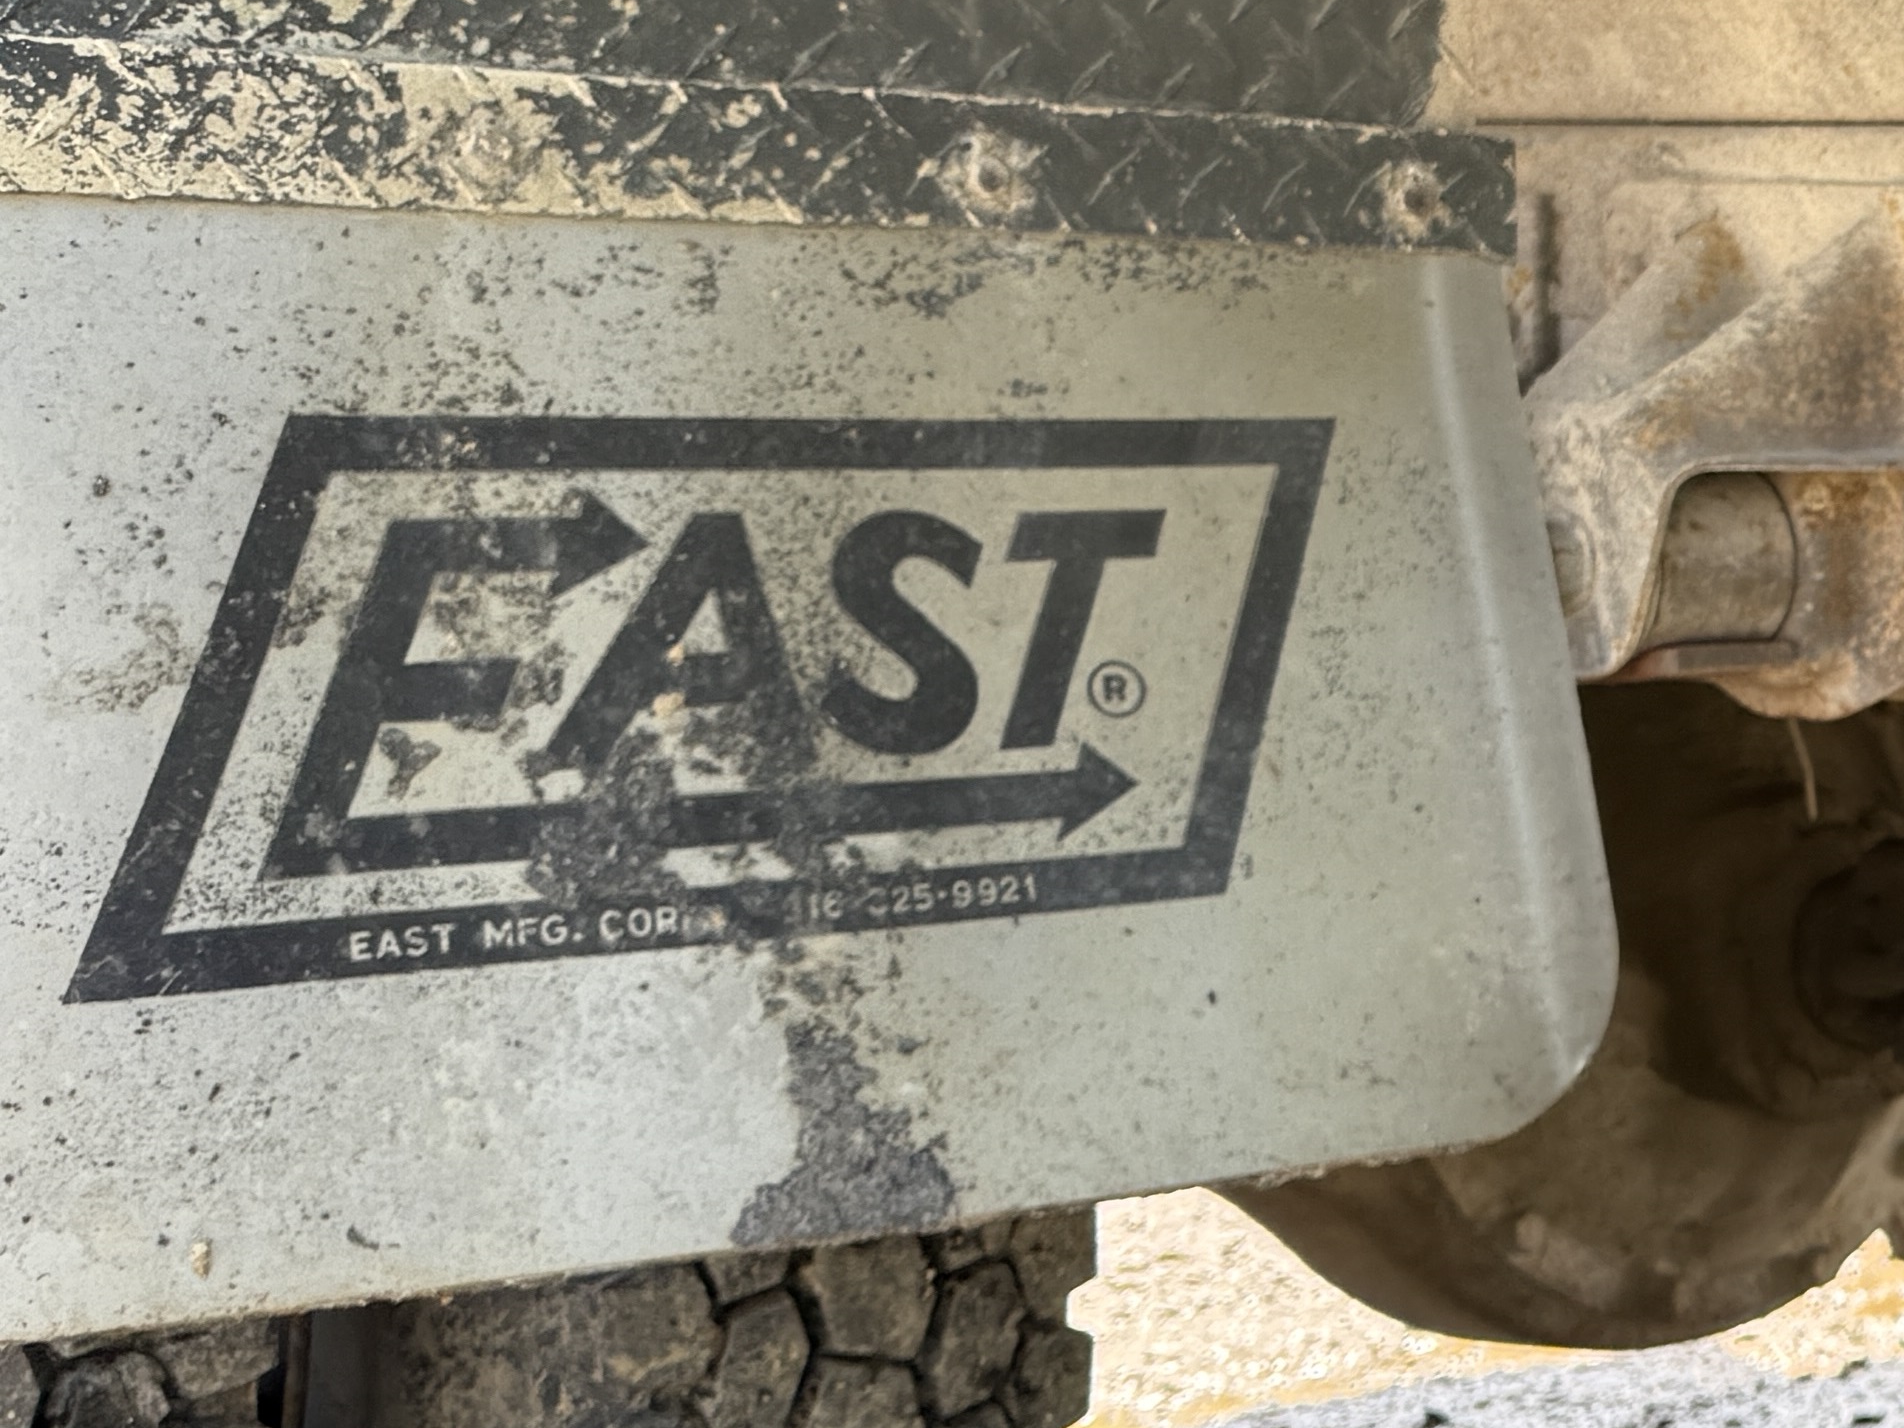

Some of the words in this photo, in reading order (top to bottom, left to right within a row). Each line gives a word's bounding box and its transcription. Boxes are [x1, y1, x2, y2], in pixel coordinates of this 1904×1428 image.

[260, 490, 1168, 880] EAST
[349, 923, 455, 962] EAST
[482, 914, 584, 950] MFG.
